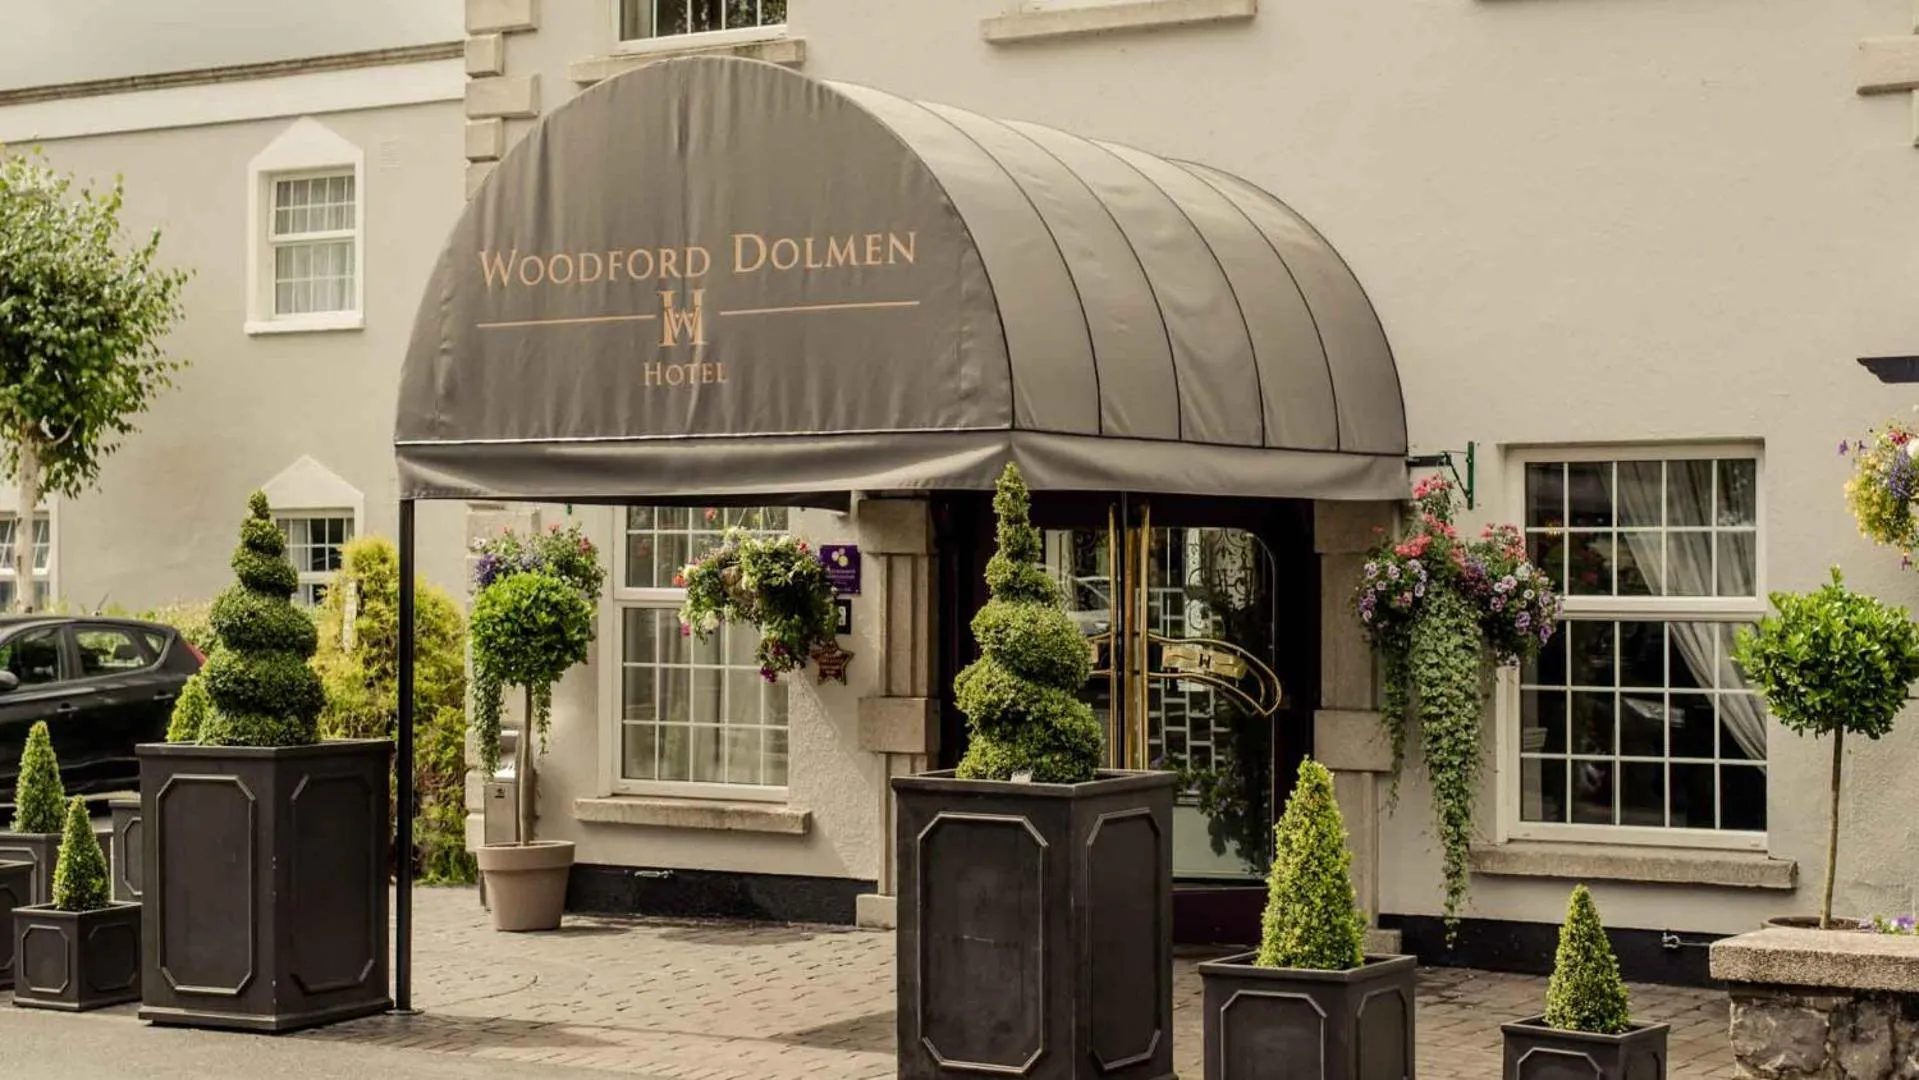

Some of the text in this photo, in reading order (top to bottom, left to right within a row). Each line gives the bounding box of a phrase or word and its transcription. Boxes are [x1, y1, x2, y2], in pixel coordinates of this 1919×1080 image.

[478, 231, 917, 288] WOODFORD DOLMEN
[643, 361, 728, 386] HOTEL
